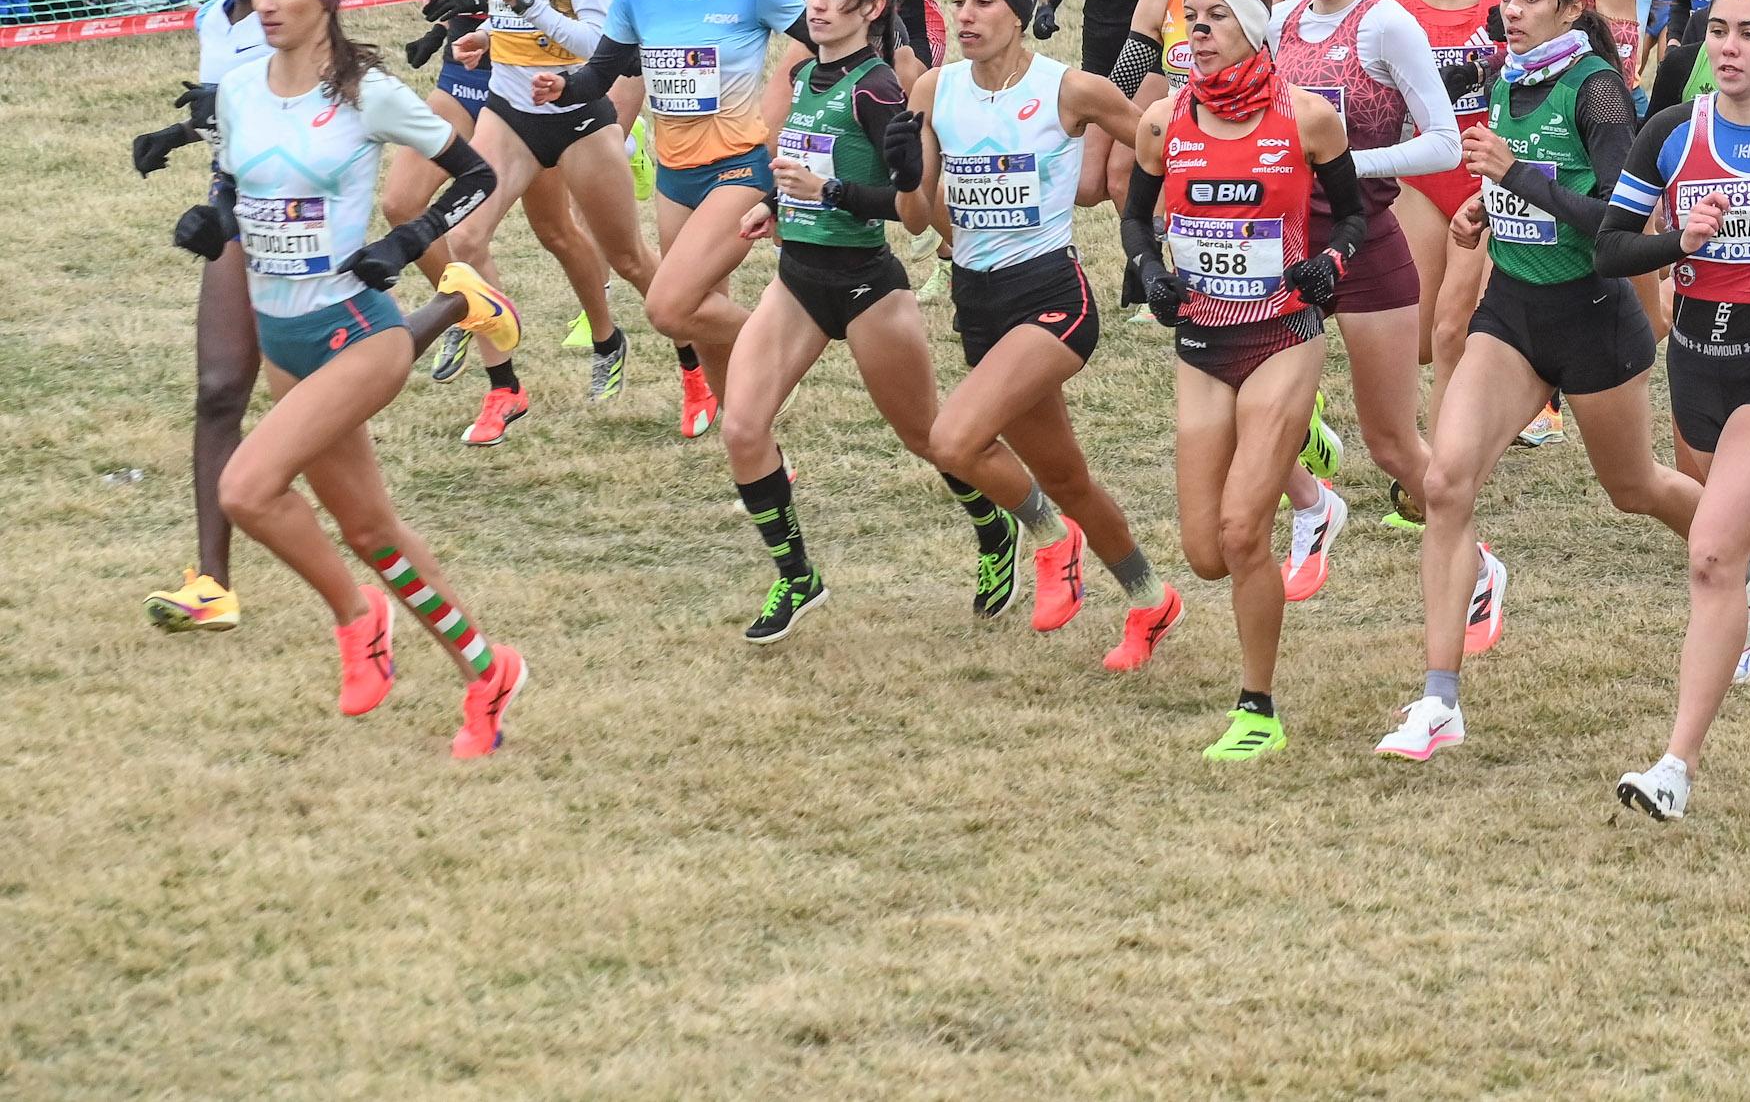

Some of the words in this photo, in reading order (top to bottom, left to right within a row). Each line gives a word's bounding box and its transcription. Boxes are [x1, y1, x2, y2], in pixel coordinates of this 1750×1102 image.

[703, 12, 740, 24] HOKA
[717, 167, 753, 181] HOKA
[957, 176, 991, 185] Ibercaja
[948, 185, 1030, 205] NAAYOUF
[1217, 184, 1257, 201] BM
[1489, 190, 1530, 217] 1562
[964, 209, 1029, 229] Joma
[1180, 219, 1234, 230] DIPUTACIÓN
[1180, 228, 1234, 238] BURGOS
[1196, 240, 1233, 249] Ibercaja
[1199, 252, 1247, 276] 958
[1203, 278, 1267, 297] Joma
[1702, 344, 1742, 357] ARMOUR
